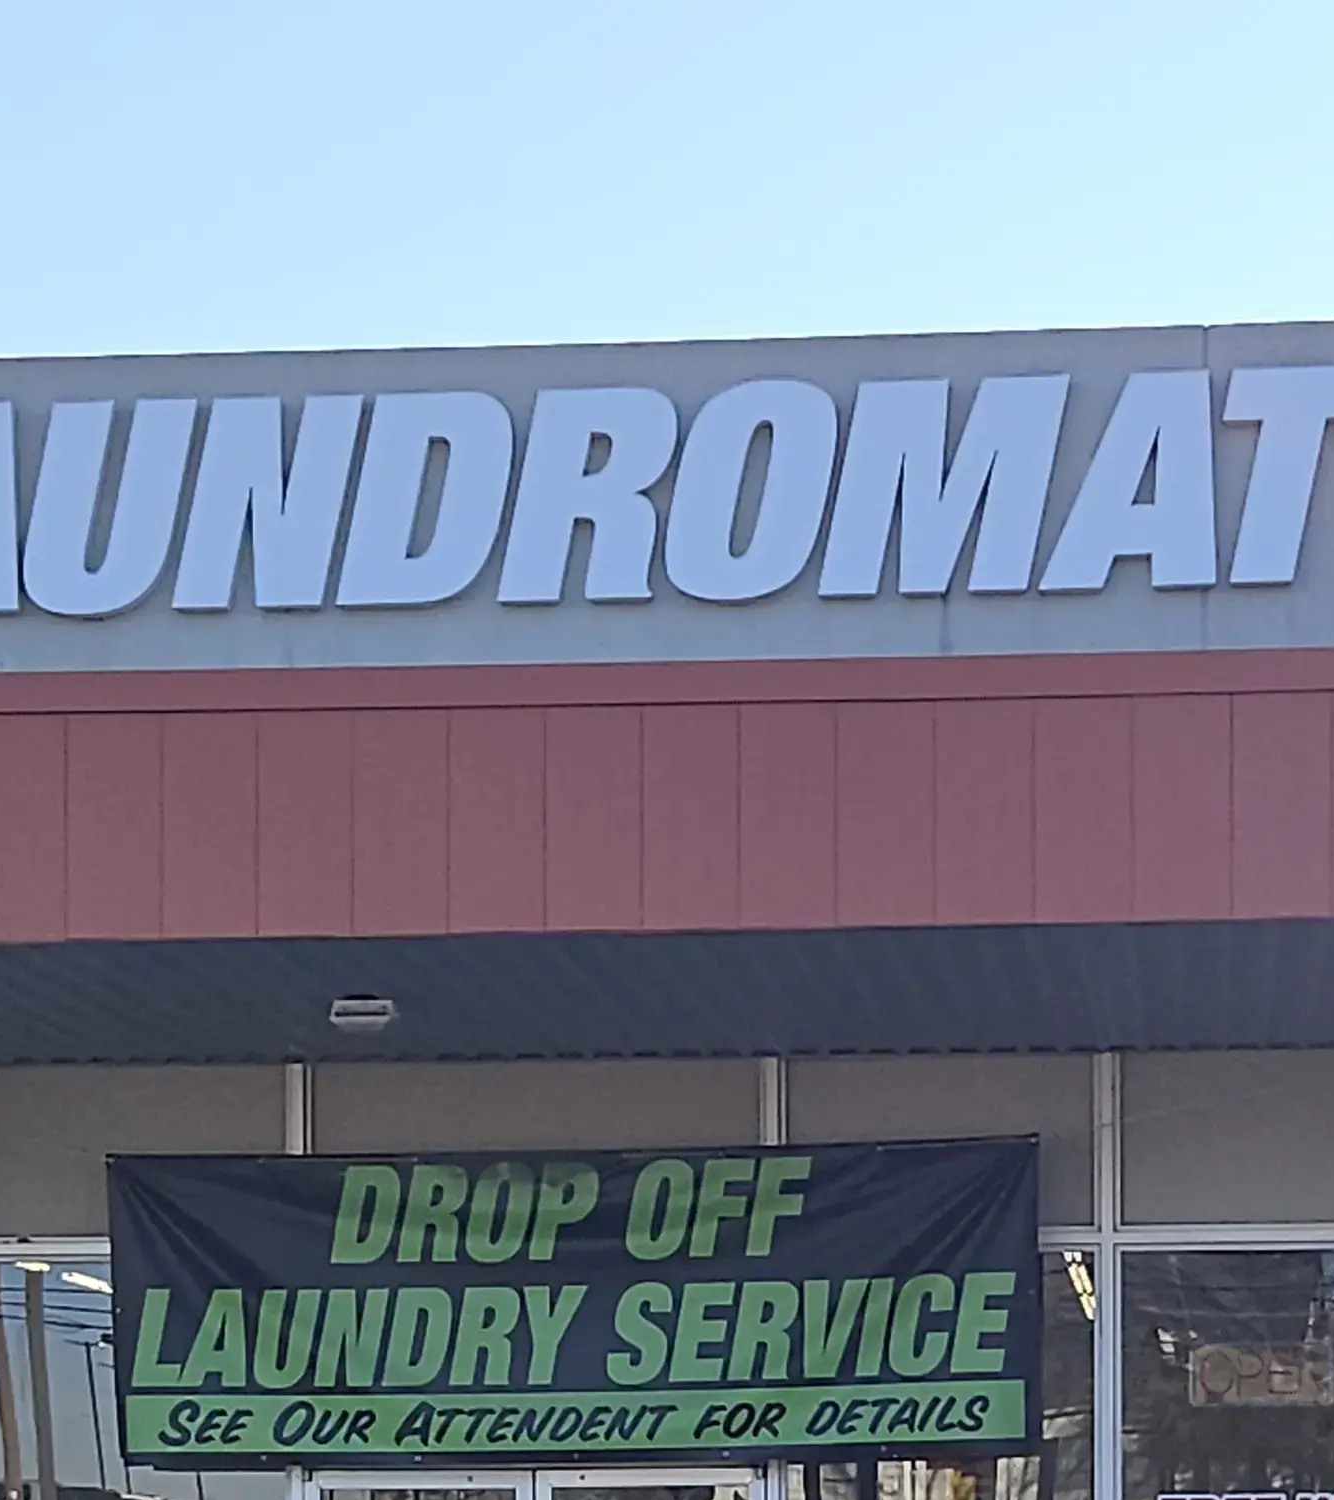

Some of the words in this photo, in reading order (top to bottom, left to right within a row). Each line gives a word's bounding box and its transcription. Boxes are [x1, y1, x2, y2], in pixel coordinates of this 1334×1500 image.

[330, 1161, 599, 1265] DROP
[624, 1156, 813, 1258] OFF
[130, 1284, 588, 1389] LAUNDRY
[605, 1271, 1016, 1385] SERVICE
[157, 1399, 254, 1447] SEE
[272, 1399, 376, 1447] OUR
[394, 1398, 675, 1445] ATTENDENT
[693, 1400, 787, 1439] FOR
[805, 1396, 991, 1436] DETAILS
